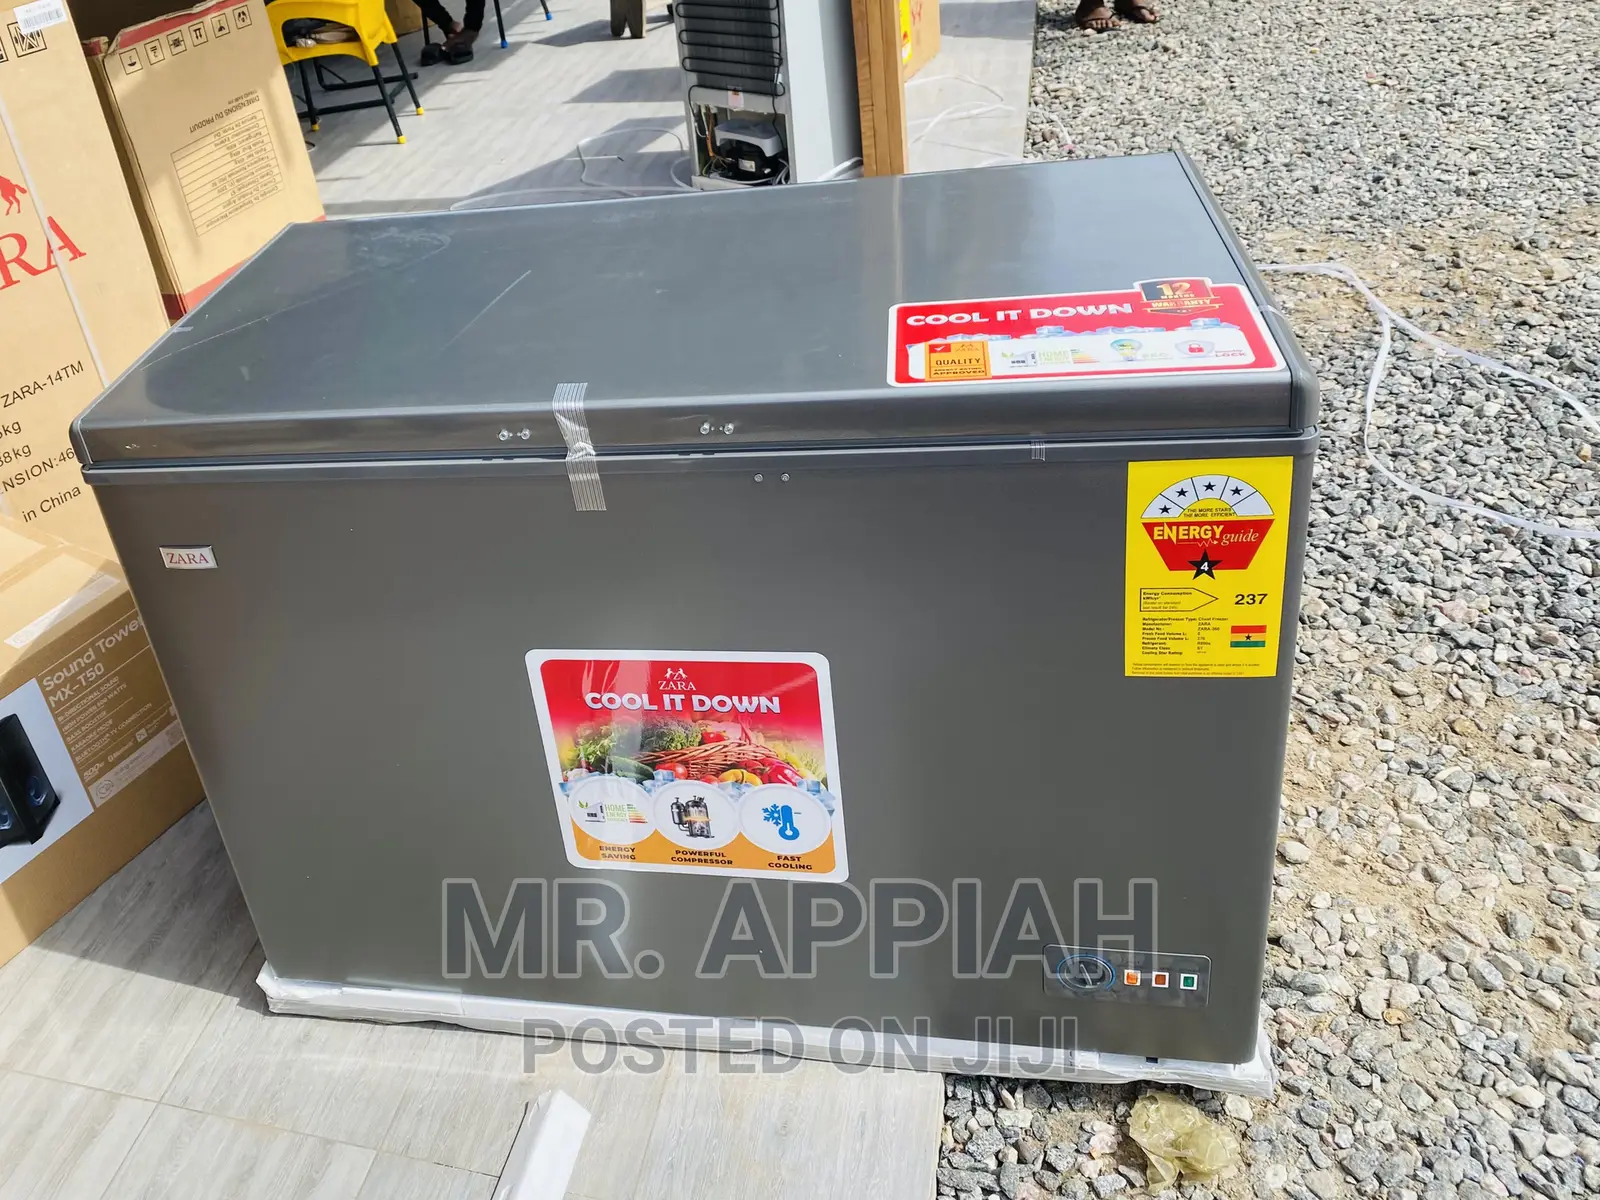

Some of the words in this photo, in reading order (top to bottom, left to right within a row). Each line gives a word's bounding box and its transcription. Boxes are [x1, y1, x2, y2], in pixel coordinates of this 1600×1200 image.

[224, 94, 259, 116] DIMENSIONS
[214, 111, 223, 120] DU
[189, 116, 214, 133] PRODUIT
[1157, 282, 1190, 296] 12
[906, 308, 989, 326] COOL
[996, 306, 1027, 322] IT
[1030, 302, 1133, 319] DOWN
[1, 361, 84, 408] ZARA-14TM
[0, 447, 74, 493] NSION:46
[22, 510, 37, 522] in
[40, 486, 81, 513] China
[1154, 522, 1224, 544] ENERGY
[1221, 530, 1259, 546] guide
[166, 552, 209, 564] ZARA
[1200, 562, 1209, 571] 4
[1234, 594, 1268, 605] 237
[43, 648, 96, 691] Sound
[48, 662, 104, 708] MX-T50
[100, 675, 119, 692] SOUND
[658, 680, 696, 691] ZARA
[585, 692, 658, 710] COOL
[664, 693, 685, 711] IT
[692, 694, 780, 715] DOWN
[671, 856, 733, 866] COMPRESSOR
[675, 850, 727, 858] POWERFUL
[768, 862, 812, 870] COOLING
